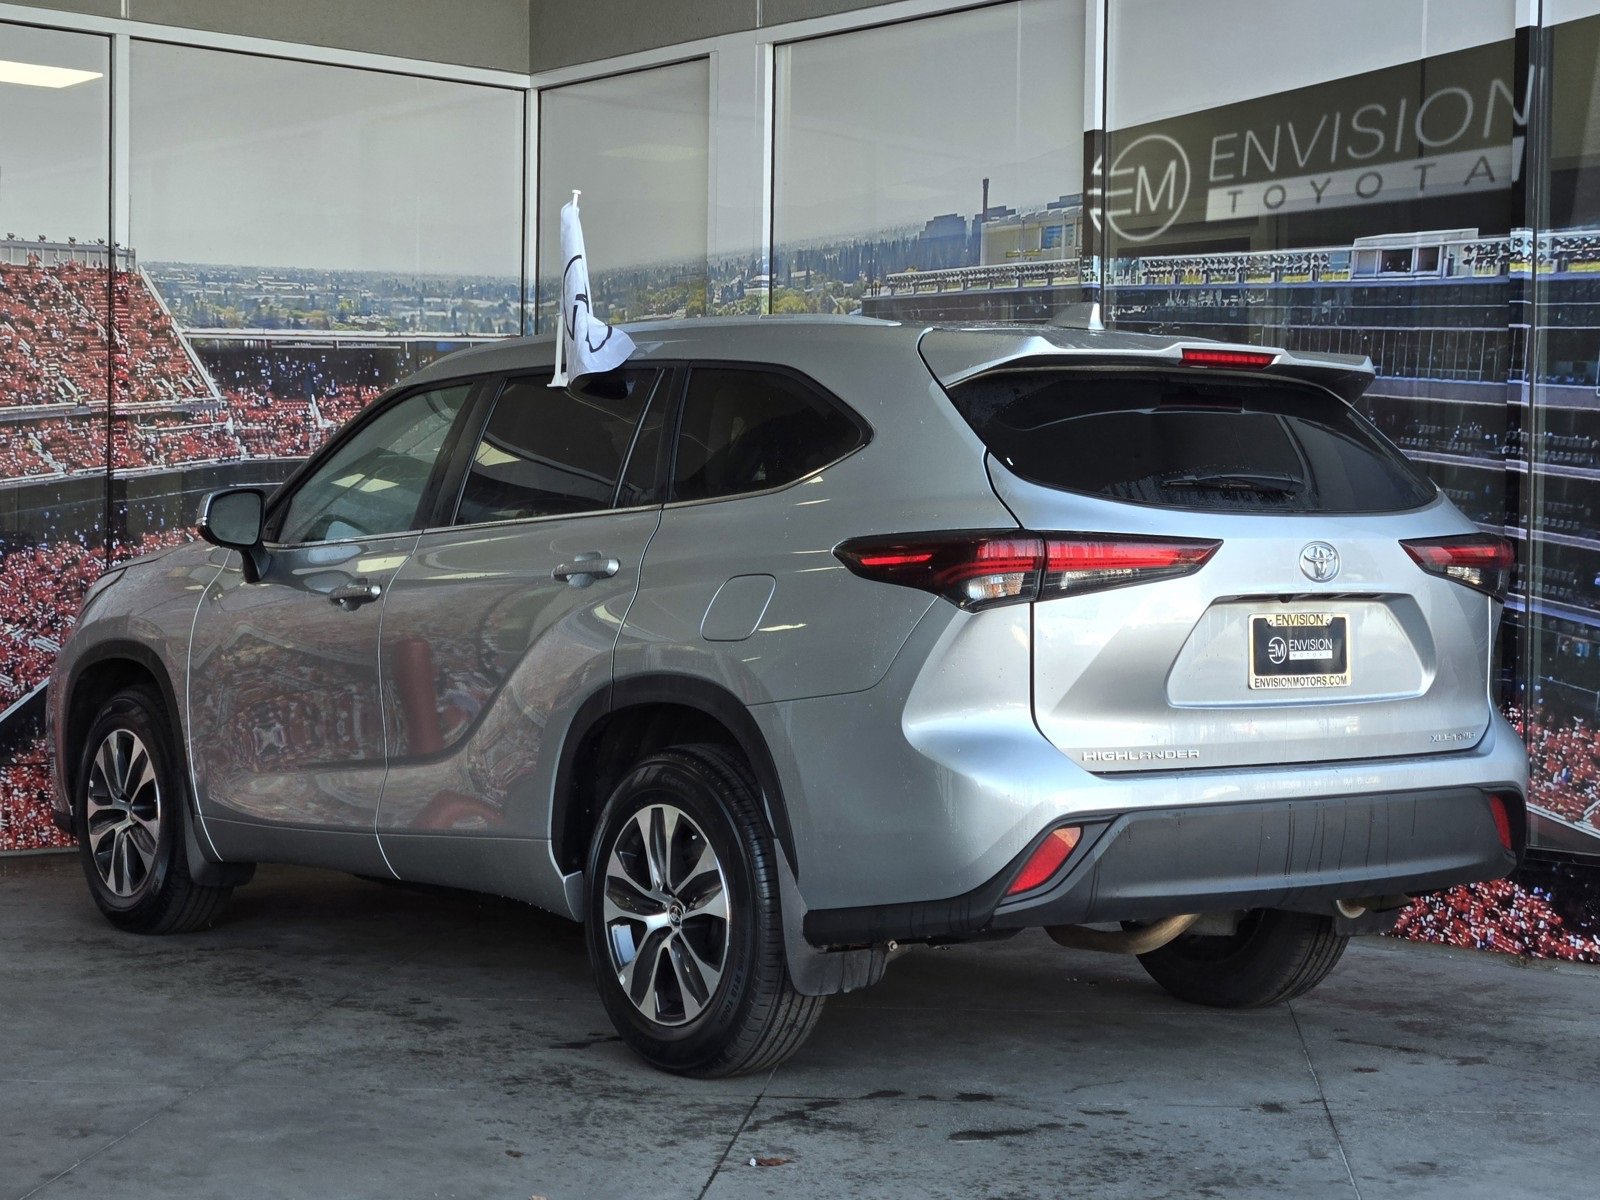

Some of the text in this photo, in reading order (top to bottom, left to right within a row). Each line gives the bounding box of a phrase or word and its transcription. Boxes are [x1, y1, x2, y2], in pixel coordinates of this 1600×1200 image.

[1208, 64, 1535, 182] ENVISION
[1227, 154, 1496, 213] TOYOTA
[1275, 614, 1324, 626] ENVISION
[1288, 638, 1333, 651] ENVISION
[1254, 675, 1347, 688] ENVISIONMOTORS.COM
[1081, 749, 1201, 761] HIGHLANDER
